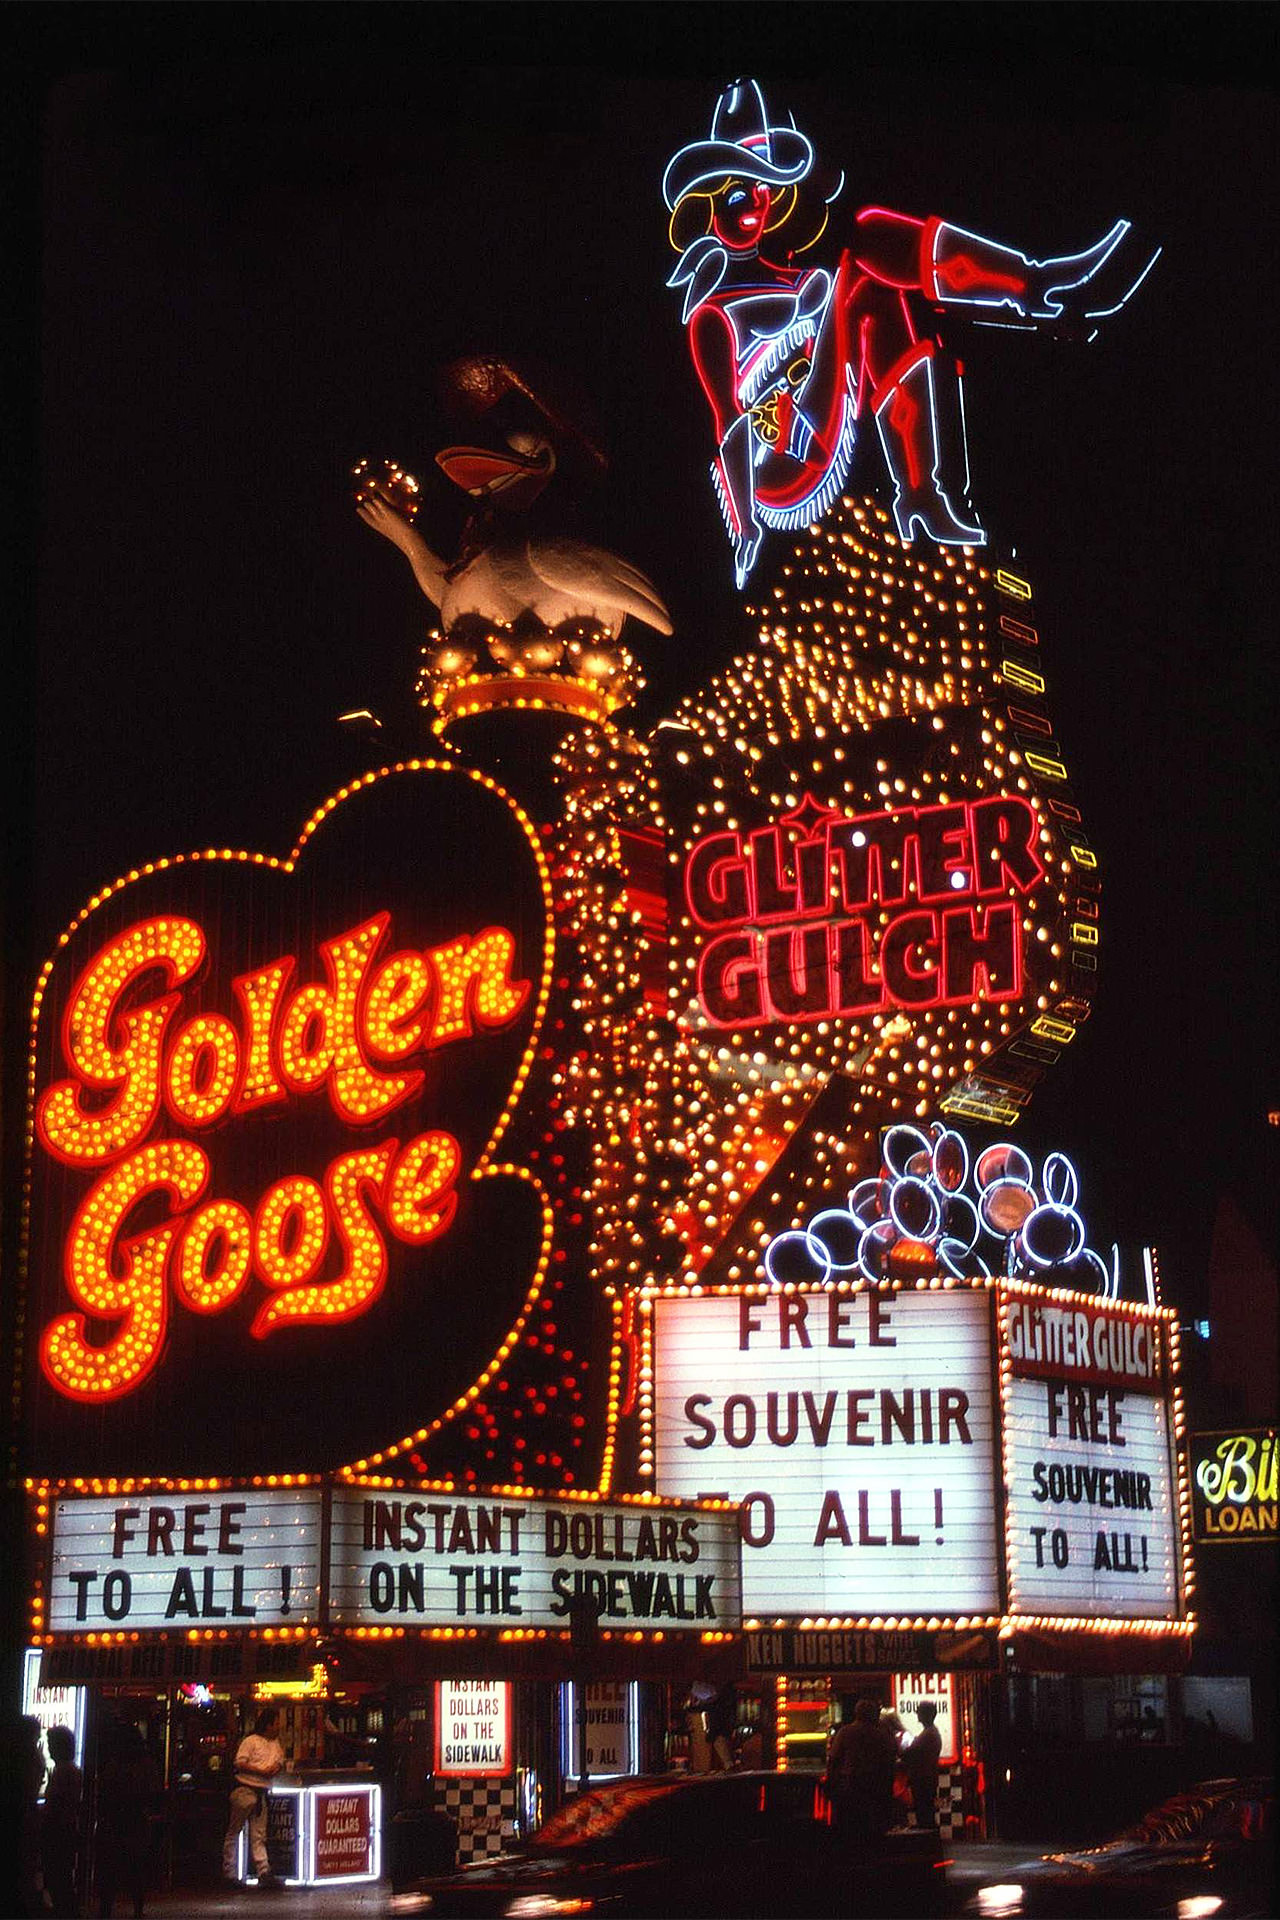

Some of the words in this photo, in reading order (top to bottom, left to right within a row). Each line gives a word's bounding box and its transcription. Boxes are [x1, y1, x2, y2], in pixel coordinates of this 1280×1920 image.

[684, 792, 1045, 930] GLITTER
[698, 903, 1023, 1029] GULCH
[37, 910, 532, 1168] Golden
[39, 1130, 462, 1403] Goose
[740, 1289, 897, 1351] FREE
[1008, 1302, 1091, 1369] GLITTER
[684, 1388, 973, 1449] SOUVENIR
[1047, 1380, 1127, 1446] FREE
[1032, 1461, 1153, 1511] SOUVENIR
[112, 1503, 246, 1559] FREE
[363, 1500, 526, 1556] INSTANT
[545, 1509, 701, 1564] DOLLARS
[698, 1491, 775, 1548] O
[814, 1489, 944, 1547] ALL!
[1030, 1526, 1069, 1568] TO
[1094, 1530, 1149, 1572] ALL!
[69, 1570, 131, 1621] TO
[369, 1561, 424, 1613] ON
[449, 1565, 522, 1616] THE
[794, 1634, 876, 1664] NUGGETS
[450, 1698, 499, 1716] DOLLARS
[453, 1722, 467, 1739] ON
[473, 1722, 494, 1739] THE
[445, 1744, 502, 1763] SIDEWALK
[325, 1817, 360, 1834] DOLLARS
[327, 1798, 359, 1814] INSTANT
[317, 1837, 368, 1855] GUARANTEED
